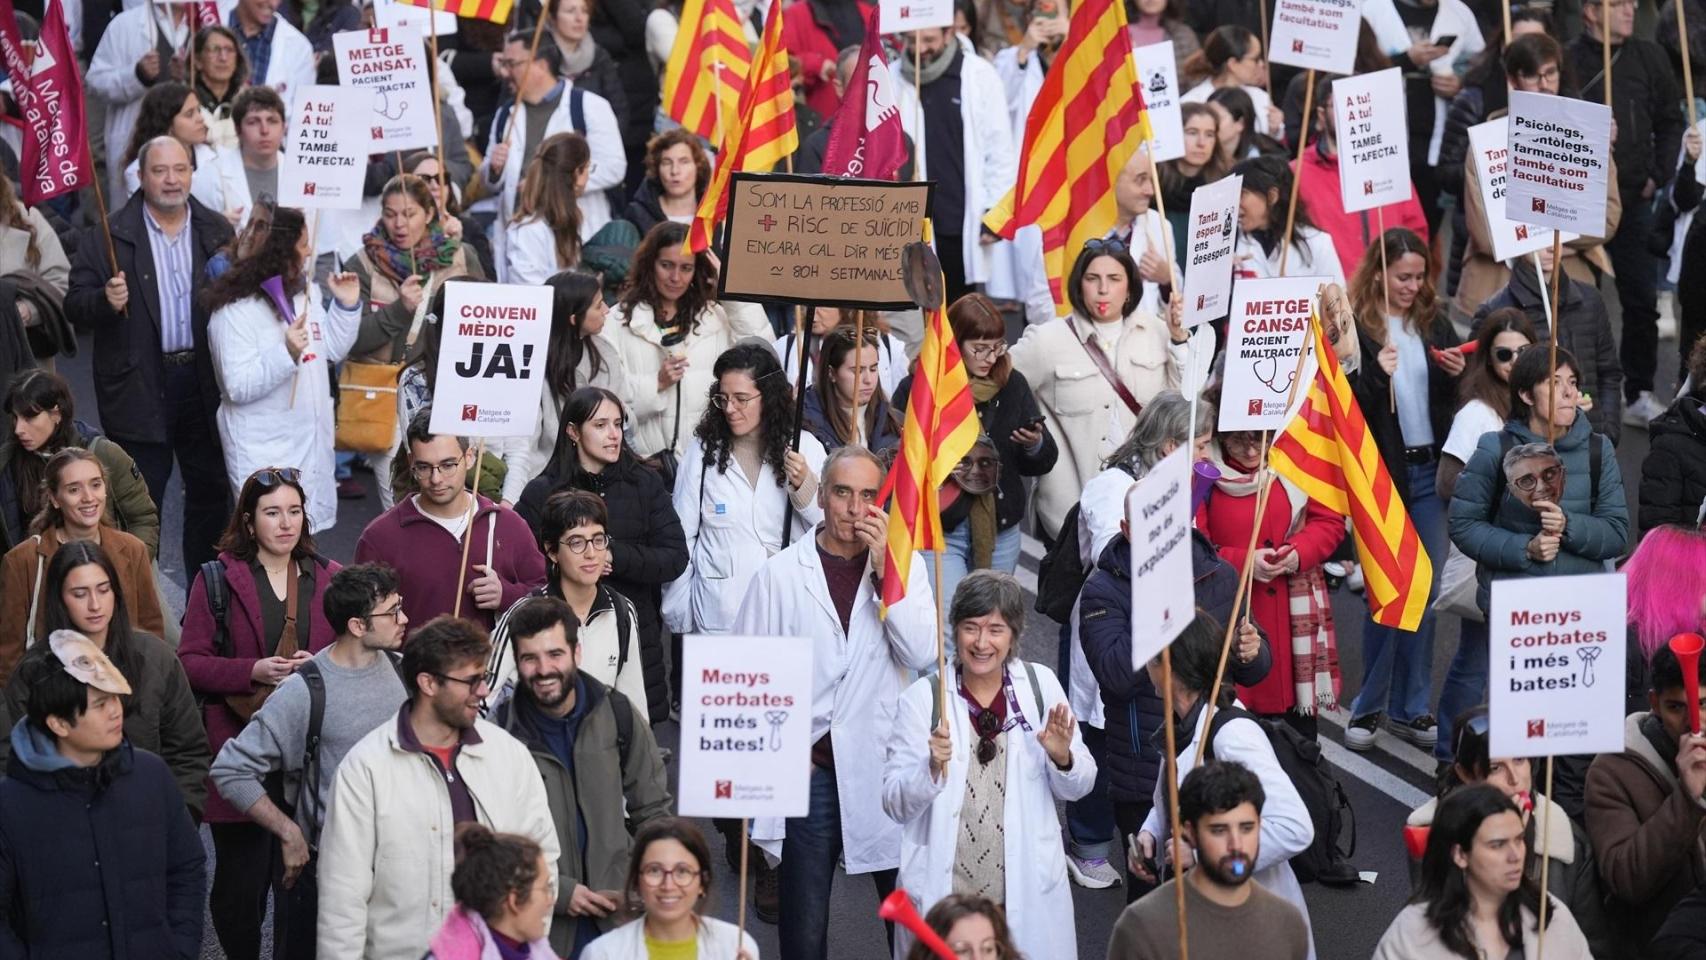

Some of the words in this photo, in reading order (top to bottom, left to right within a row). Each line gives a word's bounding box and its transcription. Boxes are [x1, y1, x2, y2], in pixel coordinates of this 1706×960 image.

[348, 44, 405, 60] METGE
[350, 58, 416, 75] CANSAT,
[352, 74, 392, 85] PACIENT
[379, 81, 416, 94] RACTAT
[1346, 96, 1354, 106] A
[1357, 92, 1370, 105] tu!
[304, 102, 313, 112] A
[318, 102, 334, 112] tu!
[1348, 111, 1355, 121] A
[1359, 107, 1372, 119] tu!
[302, 115, 311, 125] A
[316, 116, 332, 126] tu!
[1515, 116, 1584, 140] Psicòlegs,
[300, 129, 308, 138] A
[313, 130, 328, 139] TU
[1350, 126, 1356, 136] A
[1359, 123, 1371, 134] TU
[299, 140, 338, 152] TAMBÉ
[297, 155, 355, 166] T'AFECTA!
[1352, 145, 1398, 164] T'AFECTA!
[1485, 148, 1508, 161] Tan
[1514, 142, 1602, 169] farmacòlegs,
[59, 160, 78, 186] de
[1514, 156, 1555, 173] també
[1559, 167, 1588, 179] som
[1513, 169, 1585, 192] facultatius
[747, 184, 787, 209] SOM
[793, 194, 812, 210] LA
[820, 193, 886, 213] PROFESSIÓ
[892, 200, 919, 214] AMB
[1198, 212, 1219, 226] Tanta
[841, 222, 858, 235] DE
[1196, 223, 1222, 240] espera
[747, 239, 801, 256] ENCARA
[808, 244, 835, 257] CAL
[844, 245, 866, 260] DIR
[875, 244, 900, 260] MÉS
[1194, 239, 1209, 253] ens
[1193, 246, 1230, 266] desespera
[793, 265, 819, 279] 80H
[460, 305, 537, 320] CONVENI
[1245, 299, 1309, 315] METGE
[458, 321, 515, 337] MÈDIC
[1242, 336, 1290, 346] PACIENT
[1240, 347, 1312, 358] MALTRACTT
[455, 342, 534, 379] JA!
[477, 416, 510, 424] Catalunya
[478, 409, 502, 418] Metges
[1148, 524, 1161, 542] no
[1138, 526, 1186, 578] explotació
[1511, 610, 1582, 626] Menys
[1510, 630, 1607, 648] corbates
[1510, 656, 1515, 670] i
[1524, 653, 1569, 669] més
[702, 669, 770, 687] Menys
[1510, 673, 1576, 692] bates!
[701, 692, 794, 707] corbates
[701, 714, 705, 728] i
[714, 714, 757, 729] més
[700, 736, 764, 751] bates!
